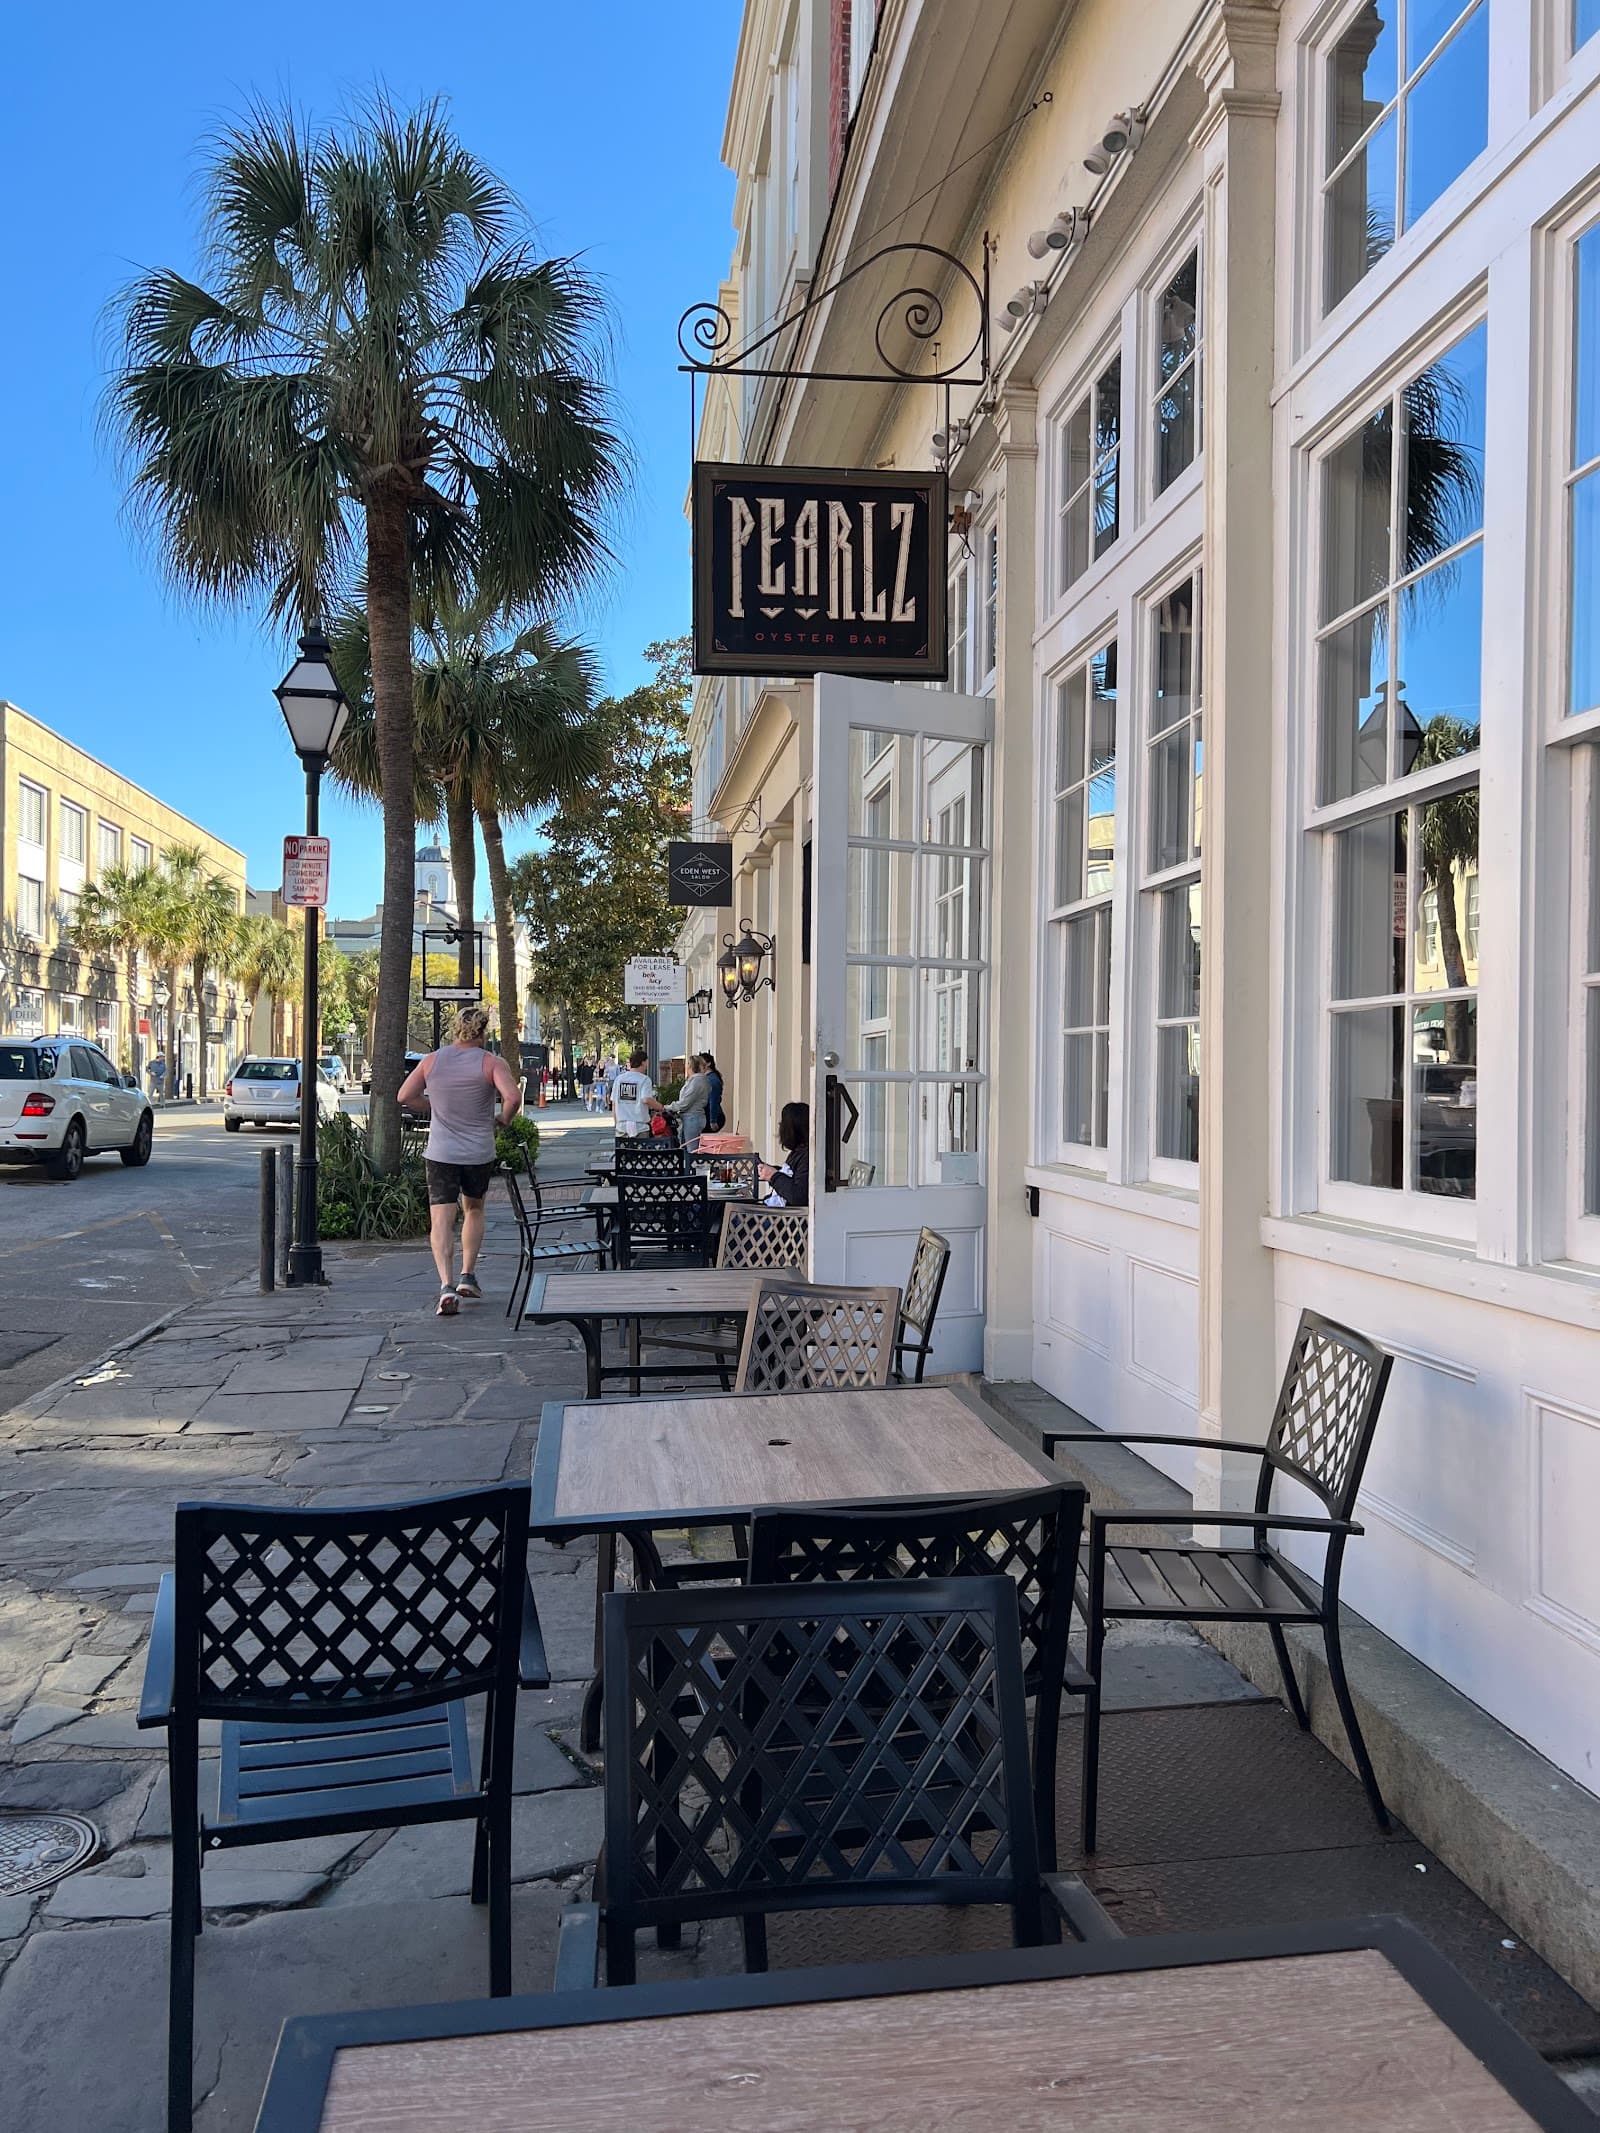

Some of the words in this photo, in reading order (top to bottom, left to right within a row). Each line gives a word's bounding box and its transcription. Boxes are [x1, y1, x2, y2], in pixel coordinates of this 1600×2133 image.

[727, 496, 916, 623] PEARLZ
[754, 632, 835, 644] OYSTER
[849, 634, 887, 645] BAR
[286, 842, 298, 855] NO
[300, 846, 328, 854] PARKING
[680, 867, 700, 875] EDEN
[16, 1010, 38, 1019] DHR
